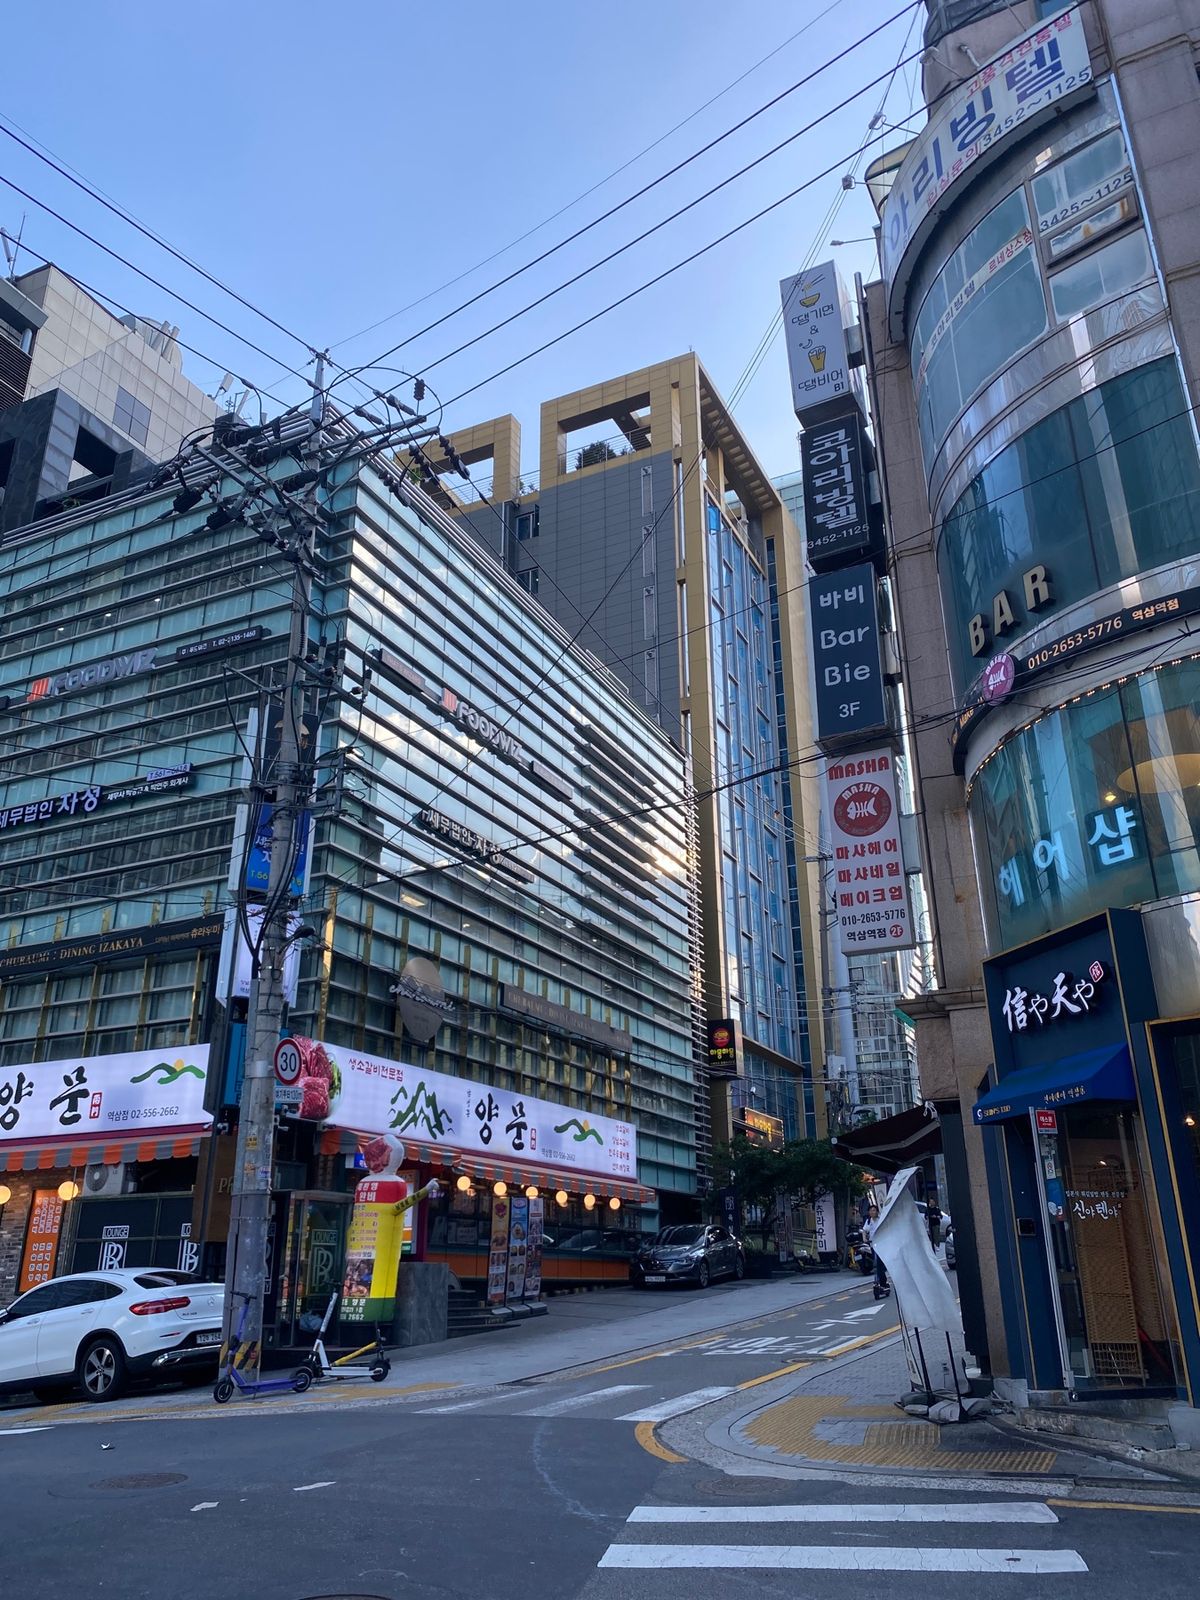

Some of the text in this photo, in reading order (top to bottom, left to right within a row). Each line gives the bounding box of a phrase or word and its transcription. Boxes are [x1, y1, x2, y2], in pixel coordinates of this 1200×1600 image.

[807, 523, 870, 549] 3452-1125
[819, 585, 864, 609] 바비
[968, 564, 1051, 658] BAR
[820, 624, 870, 650] Bar
[1027, 597, 1180, 669] 010-2653-5776 역삼역점
[824, 663, 871, 687] Bie
[839, 701, 860, 718] 3F
[828, 756, 889, 780] MASHA
[835, 838, 898, 860] 마샤헤어
[838, 862, 901, 884] 마샤네일
[840, 886, 903, 907] 메이크업
[841, 908, 906, 926] 010-2653-5776
[59, 944, 96, 960] DINING
[99, 936, 144, 953] IZAKAYA
[280, 1051, 298, 1073] 30
[131, 1106, 179, 1119] 02-556-2662
[103, 1227, 129, 1239] LOUNGE
